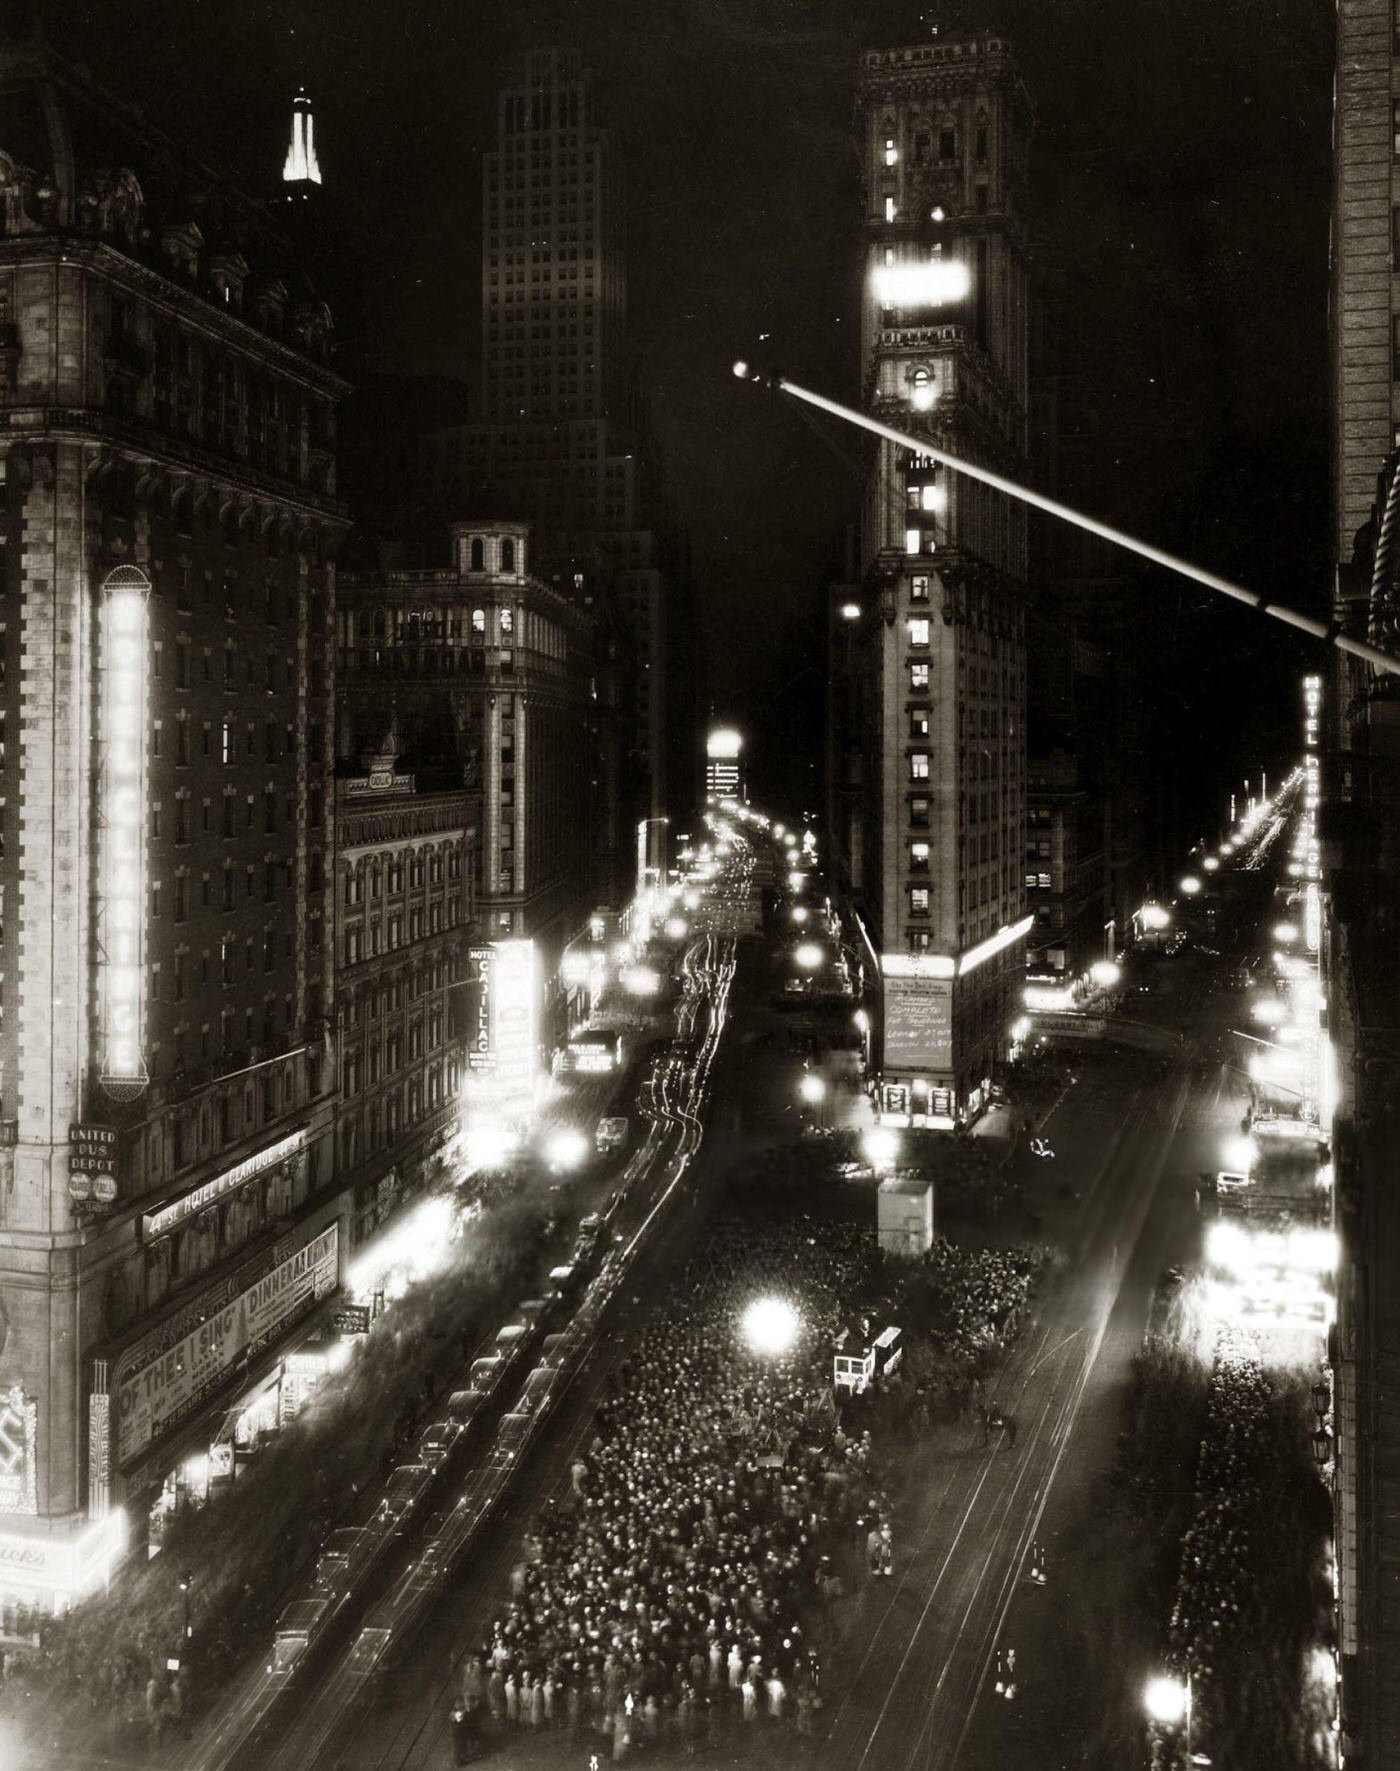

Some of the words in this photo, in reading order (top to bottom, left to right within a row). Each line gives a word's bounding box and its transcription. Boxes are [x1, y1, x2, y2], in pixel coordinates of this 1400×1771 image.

[1305, 676, 1320, 744] HOTEL
[470, 950, 497, 960] HOTEL
[71, 1129, 115, 1142] UNITED
[71, 1158, 115, 1171] DEPOT
[184, 1183, 216, 1214] HOTEL
[119, 1376, 141, 1418] OF
[143, 1344, 186, 1398] THEE
